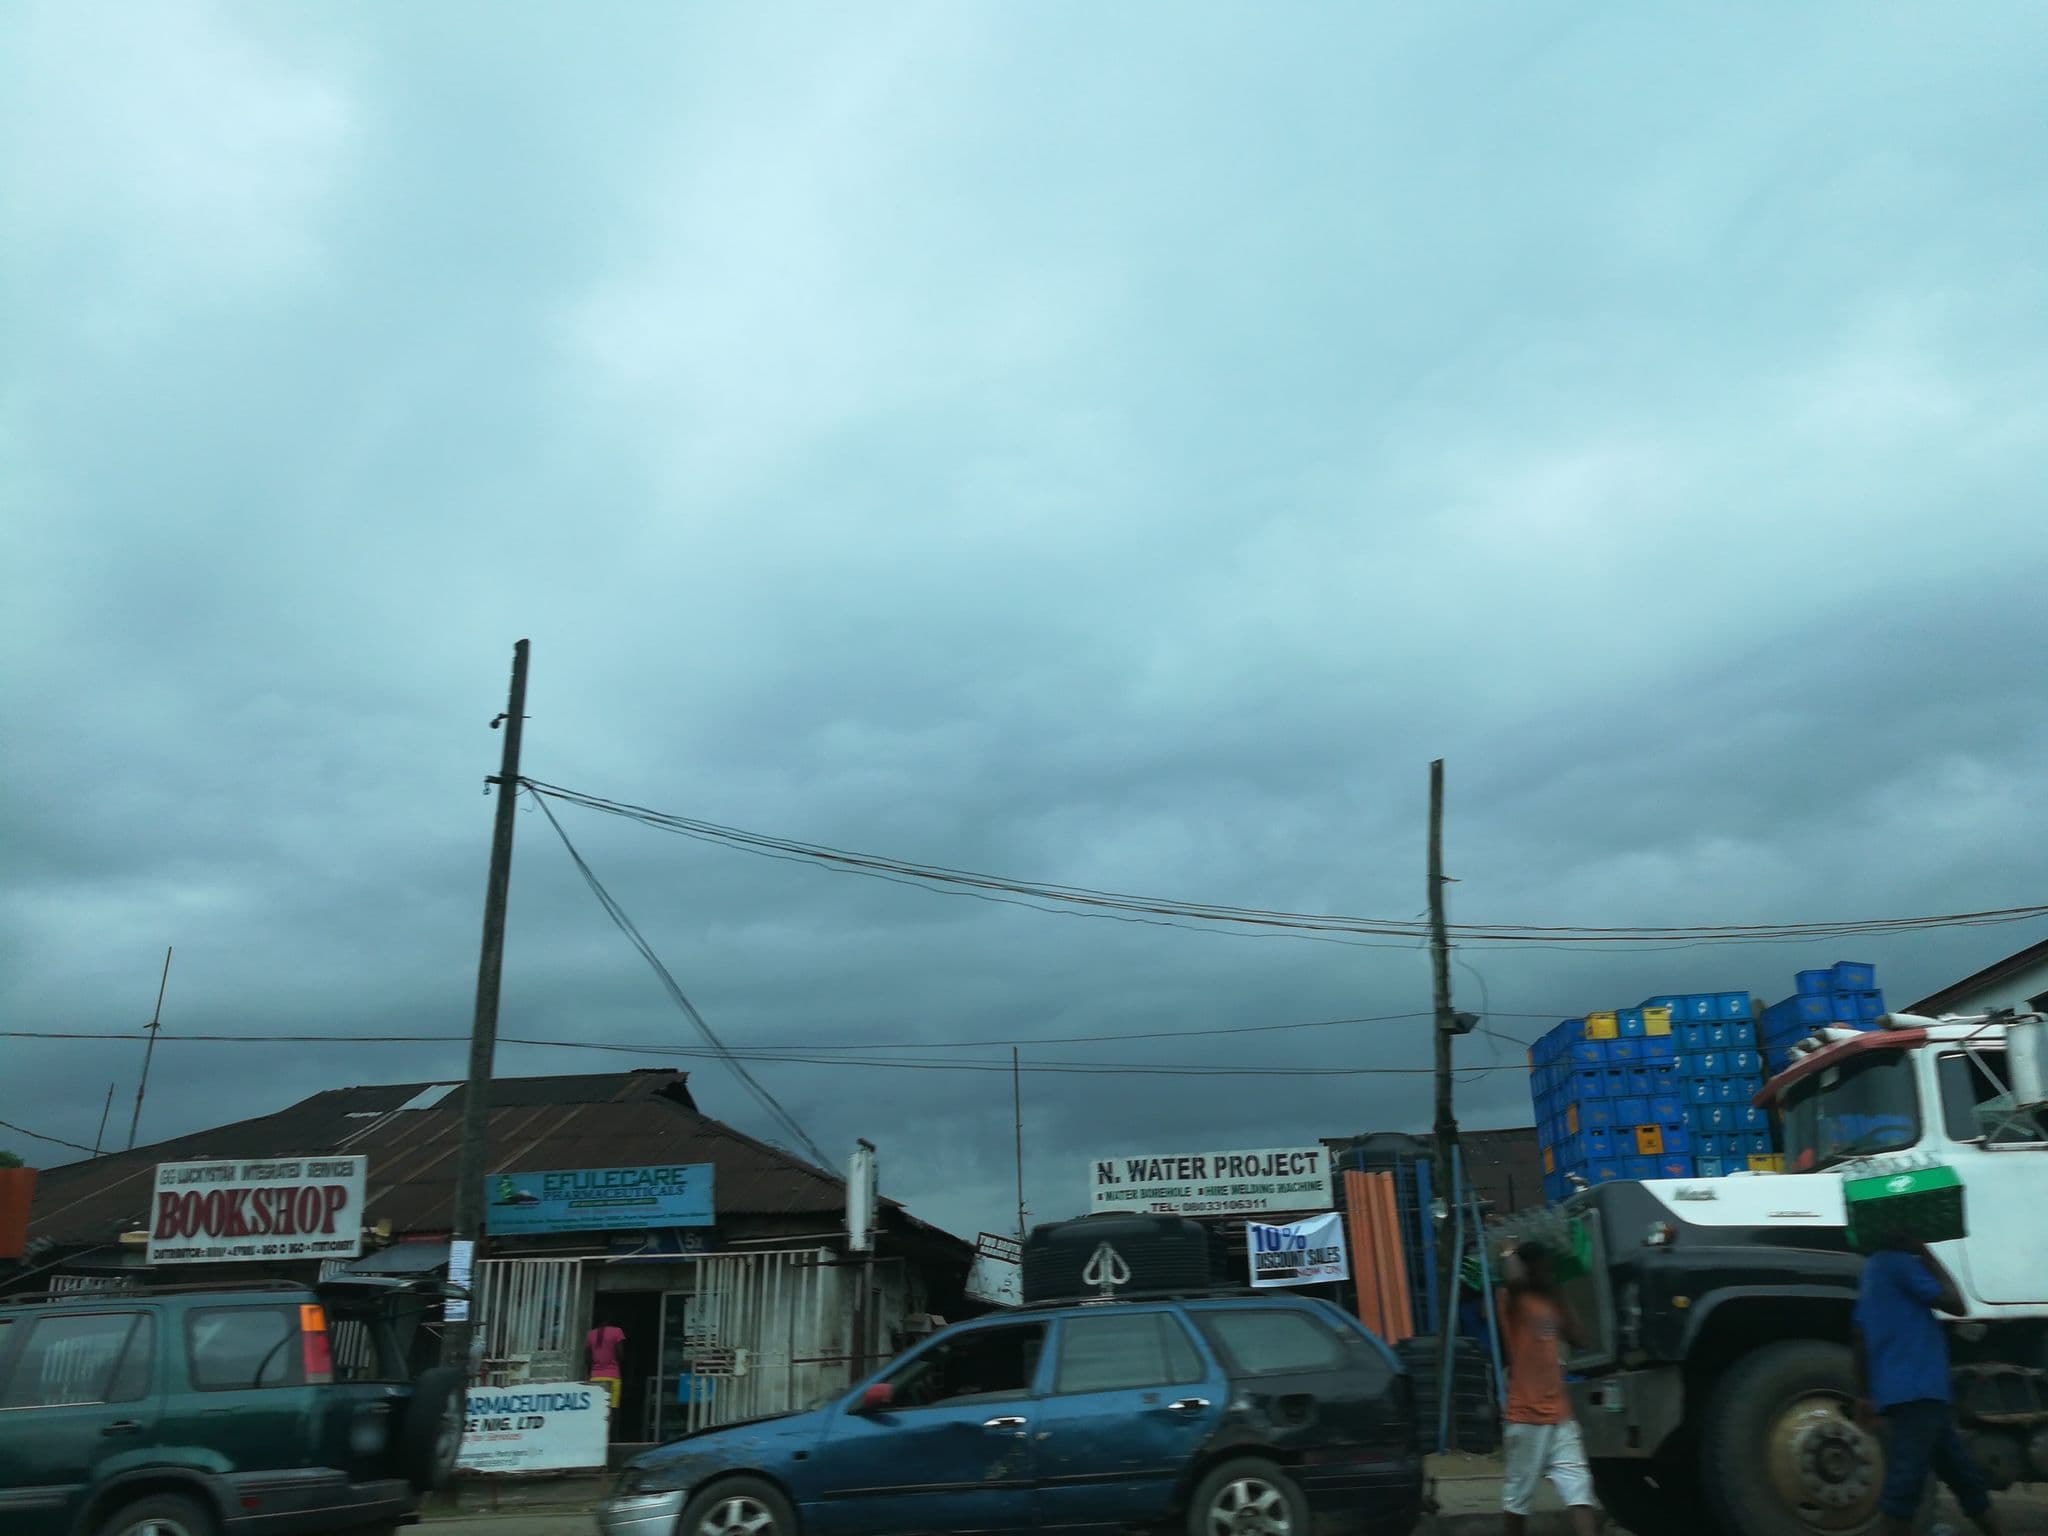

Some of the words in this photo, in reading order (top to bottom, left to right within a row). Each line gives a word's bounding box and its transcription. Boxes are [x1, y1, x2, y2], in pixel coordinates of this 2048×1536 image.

[1097, 1161, 1121, 1184] N.
[1126, 1157, 1208, 1183] WATER
[1214, 1151, 1319, 1179] PROJECT
[544, 1185, 686, 1200] PHARMACEUTICALS
[1104, 1189, 1138, 1202] WATER
[1139, 1186, 1192, 1199] BOREHOLE
[1204, 1185, 1229, 1197] HIRE
[1231, 1183, 1276, 1195] WELDING
[1277, 1180, 1323, 1194] MACHINE
[154, 1184, 347, 1240] BOOKSHOP
[1251, 1225, 1307, 1252] 10%
[1255, 1250, 1306, 1269] DISCOUNT
[1306, 1245, 1341, 1266] SALES
[465, 1391, 591, 1415] ARMACEUTICALS
[517, 1415, 545, 1430] LTD
